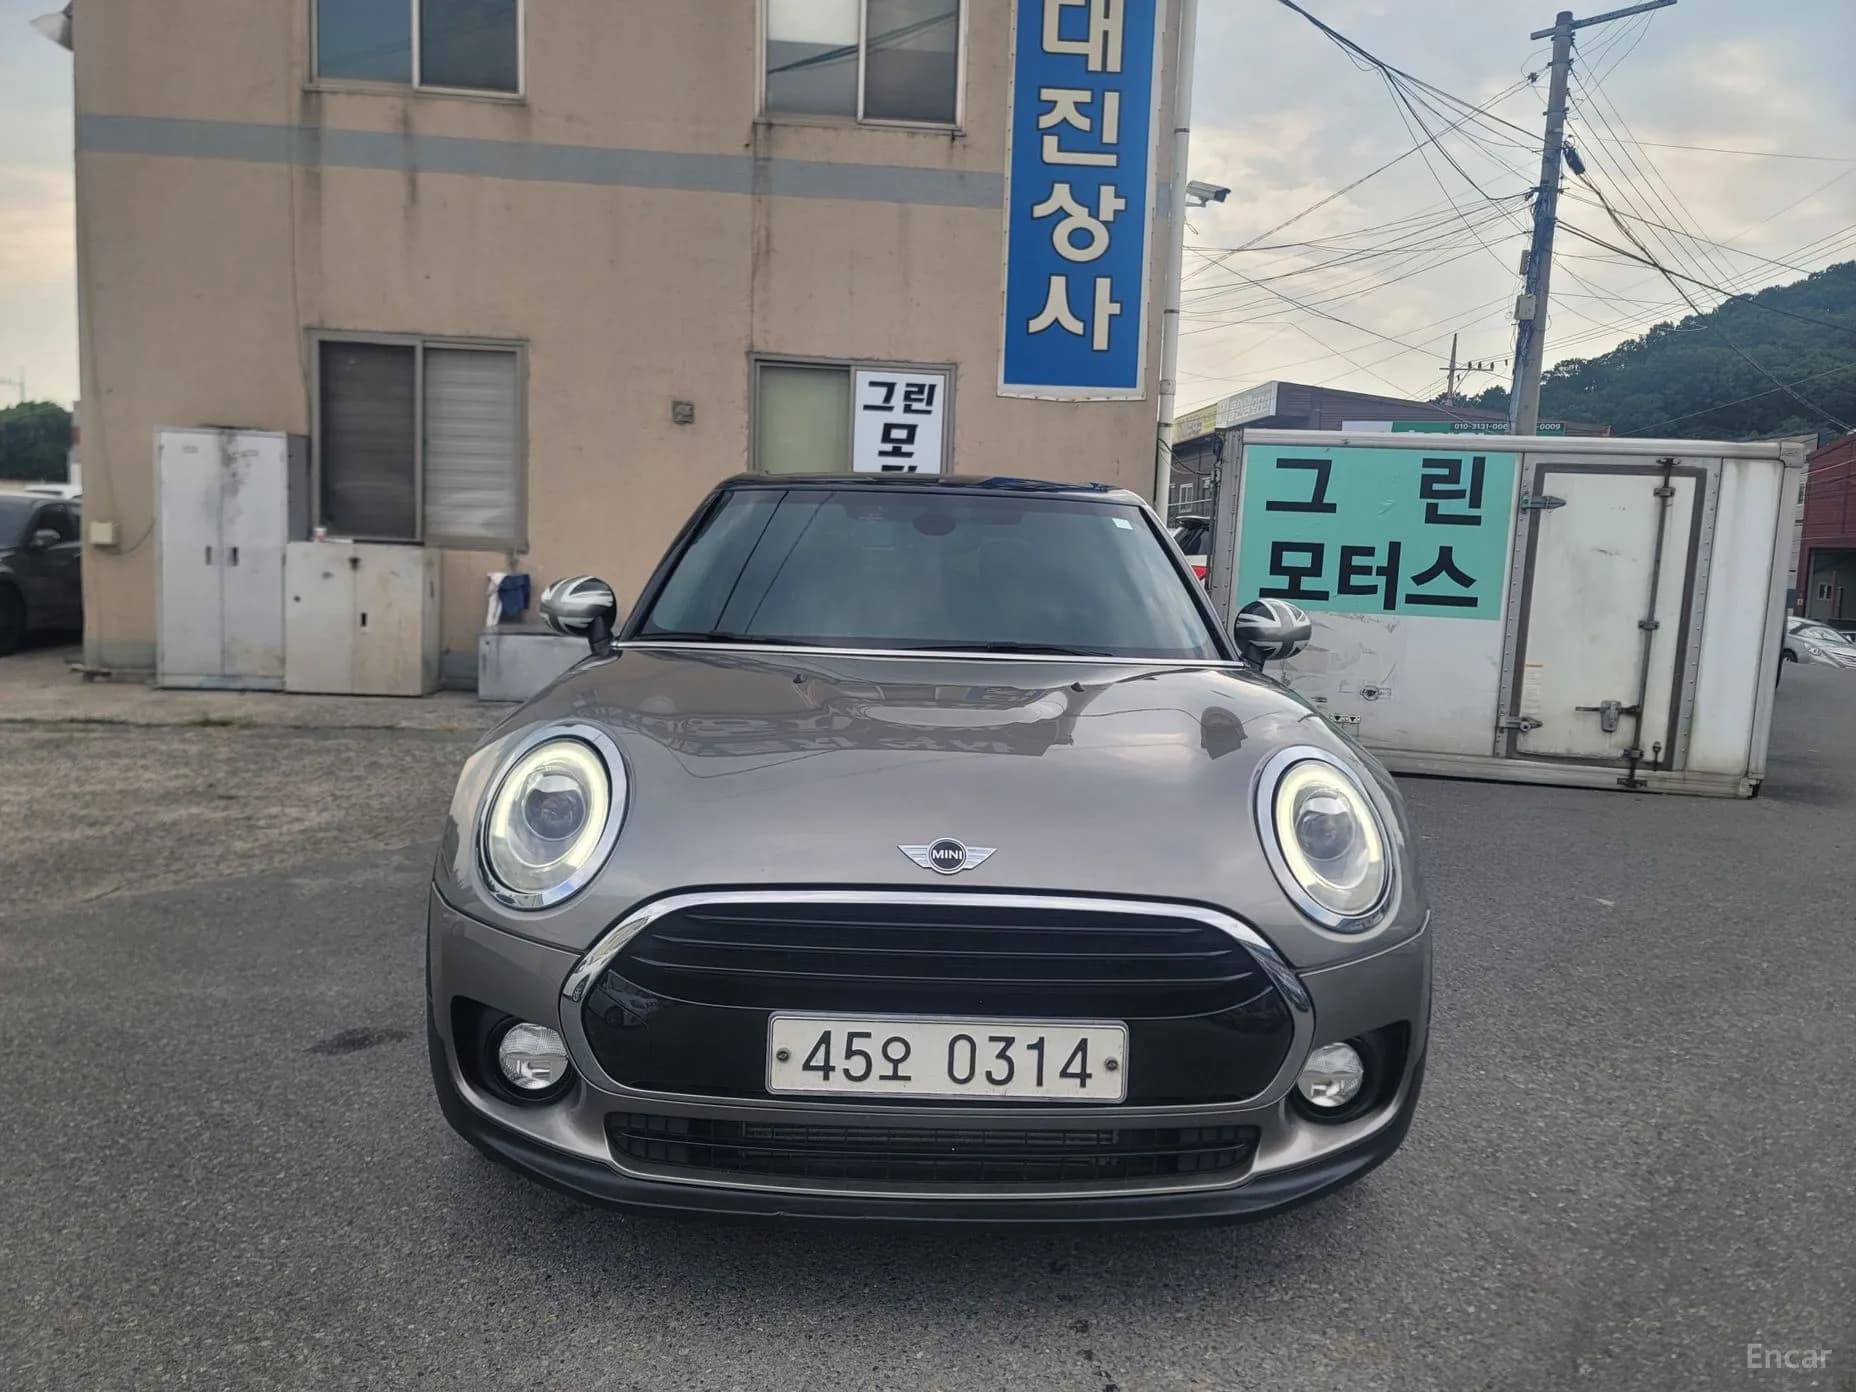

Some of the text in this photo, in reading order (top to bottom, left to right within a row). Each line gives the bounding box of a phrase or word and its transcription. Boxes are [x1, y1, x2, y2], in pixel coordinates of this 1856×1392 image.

[1027, 0, 1127, 351] 대진상사
[863, 381, 937, 415] 그린
[877, 422, 918, 472] 모
[1259, 541, 1478, 611] 모터스
[932, 849, 963, 860] MINI
[802, 1030, 1093, 1088] 45오 0314
